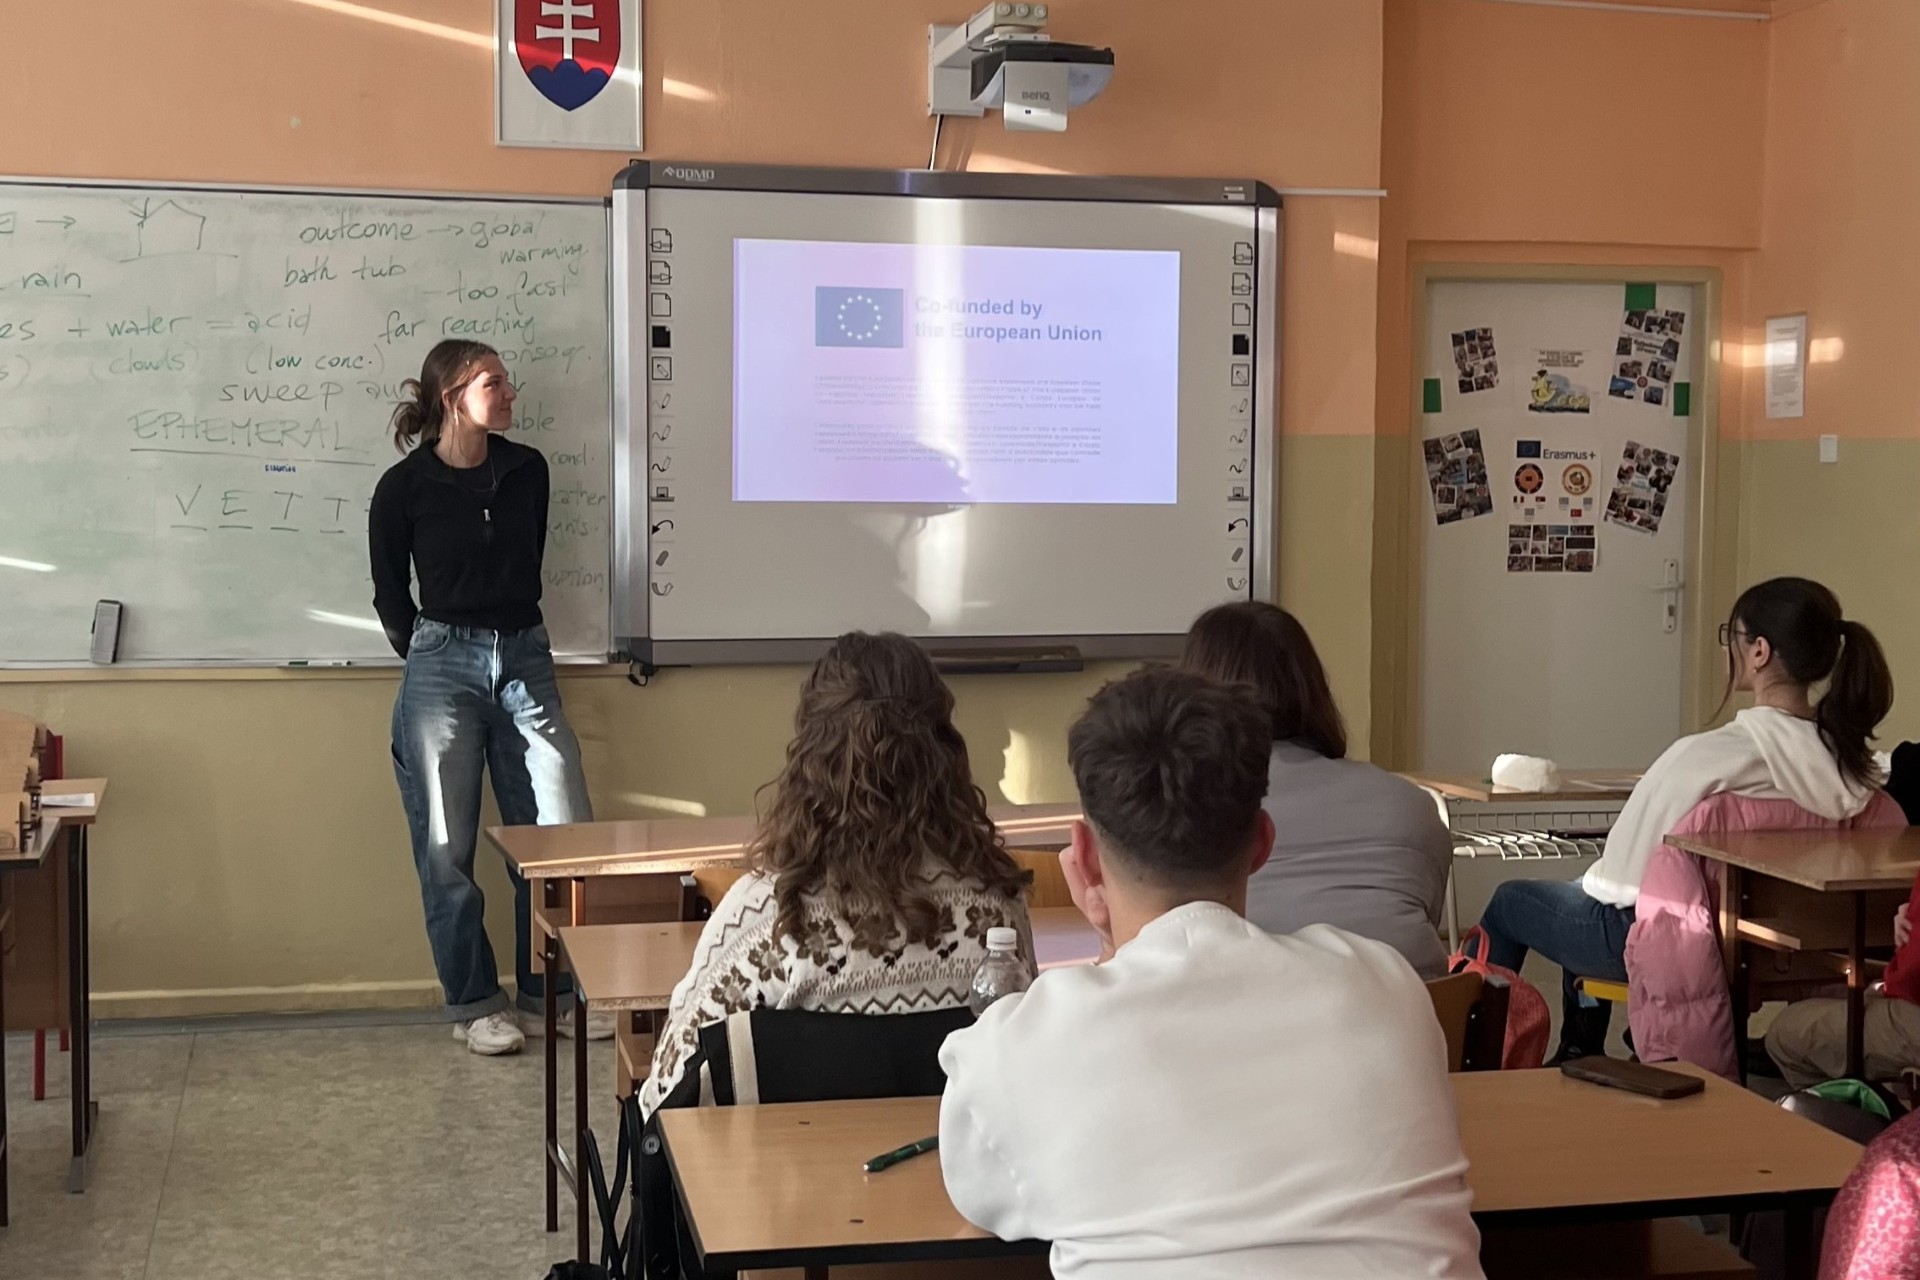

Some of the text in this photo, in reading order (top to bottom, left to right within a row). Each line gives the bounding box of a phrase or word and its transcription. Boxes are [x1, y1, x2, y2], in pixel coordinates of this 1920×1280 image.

[299, 213, 418, 243] outcome
[284, 255, 407, 288] bath tub
[500, 240, 589, 276] warming
[22, 264, 82, 289] rain
[506, 270, 570, 315] fast
[107, 306, 193, 338] water
[245, 303, 312, 336] acid
[915, 297, 1043, 320] Co-funded by
[378, 305, 536, 345] far reaching
[915, 322, 1102, 343] the European Union
[499, 345, 592, 375] onseq.
[220, 381, 344, 412] sweep
[127, 409, 352, 451] EPHEMERAL
